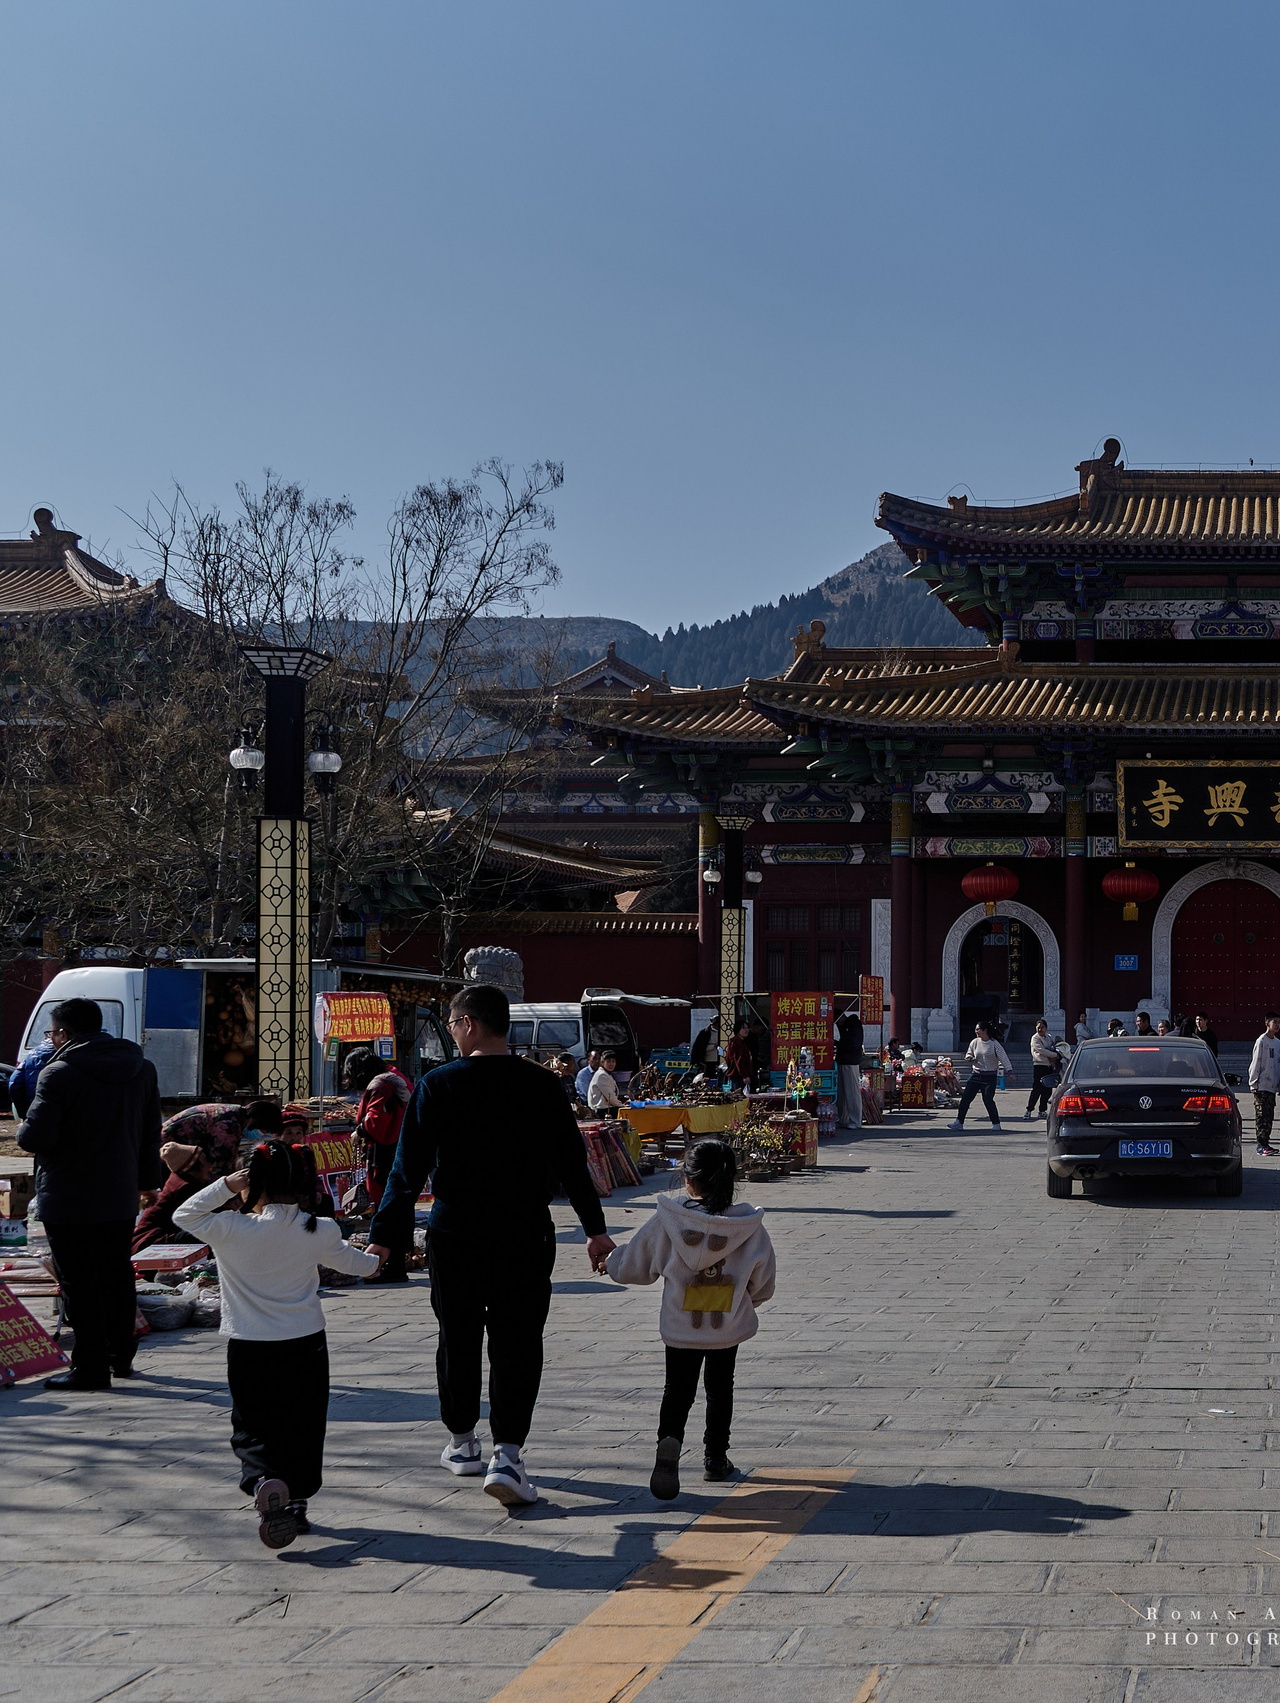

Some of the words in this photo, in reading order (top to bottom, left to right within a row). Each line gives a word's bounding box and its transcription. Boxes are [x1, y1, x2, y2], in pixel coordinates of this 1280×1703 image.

[777, 997, 817, 1017] 烤冷面
[776, 1021, 828, 1041] 鸡蛋灌饼
[902, 1079, 923, 1093] 鱼食
